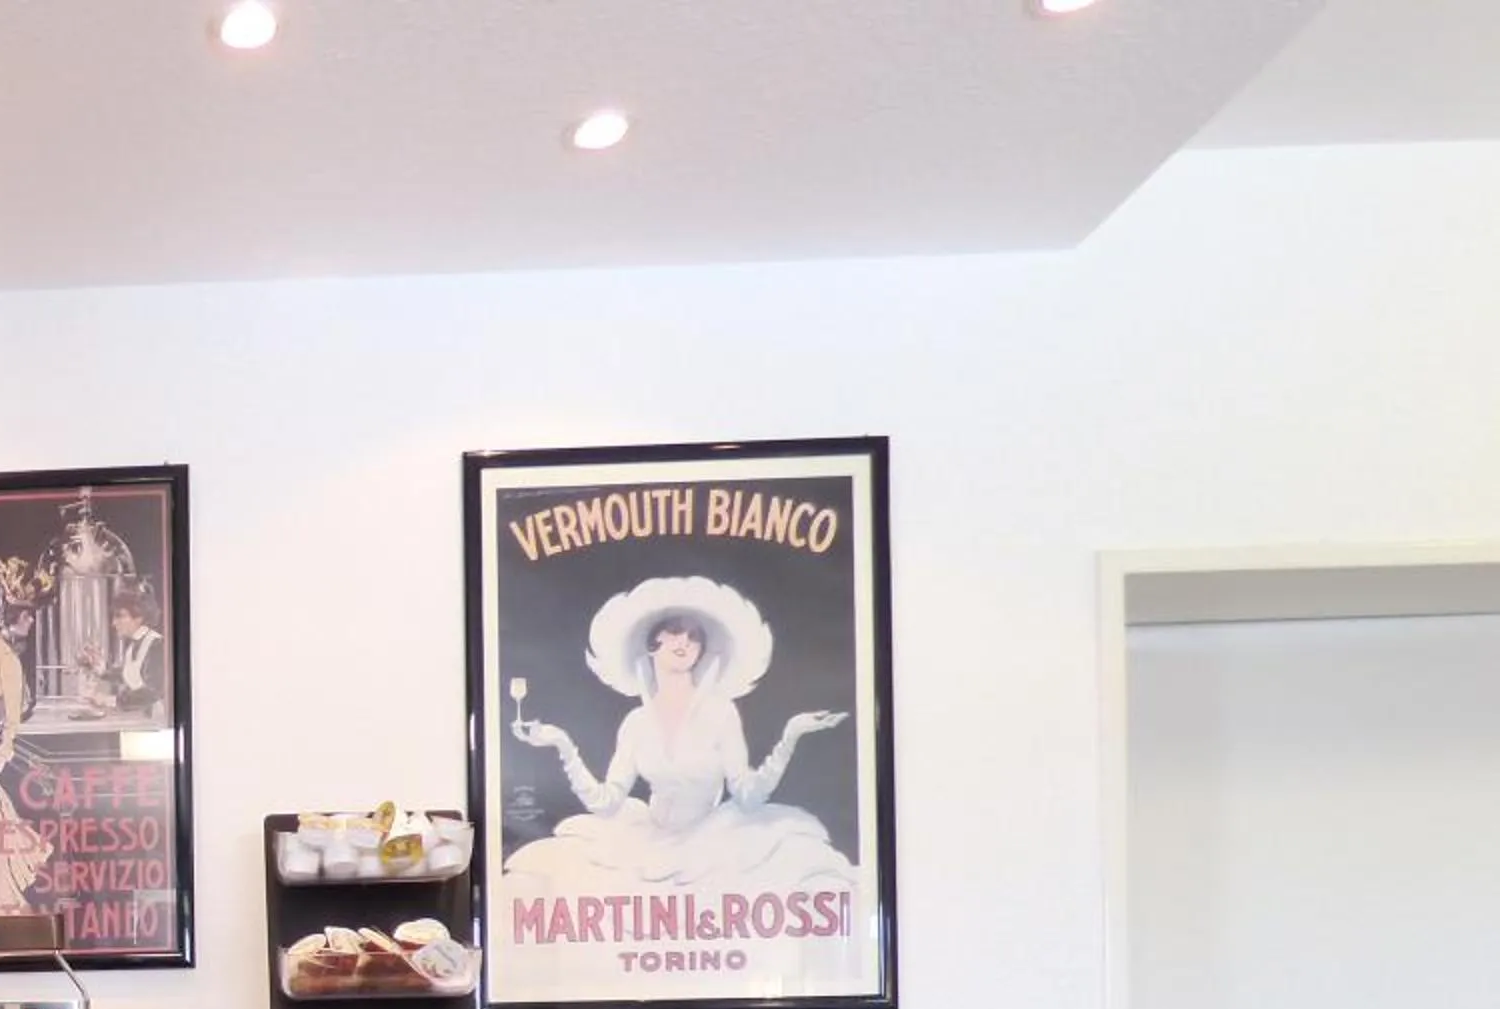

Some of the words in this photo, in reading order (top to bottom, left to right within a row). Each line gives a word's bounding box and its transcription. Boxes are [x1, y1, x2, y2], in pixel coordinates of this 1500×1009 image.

[510, 488, 694, 562] VERMOUTH
[706, 489, 838, 553] BIANCO
[34, 858, 166, 893] SERVIZIO
[618, 949, 748, 973] TORINO
